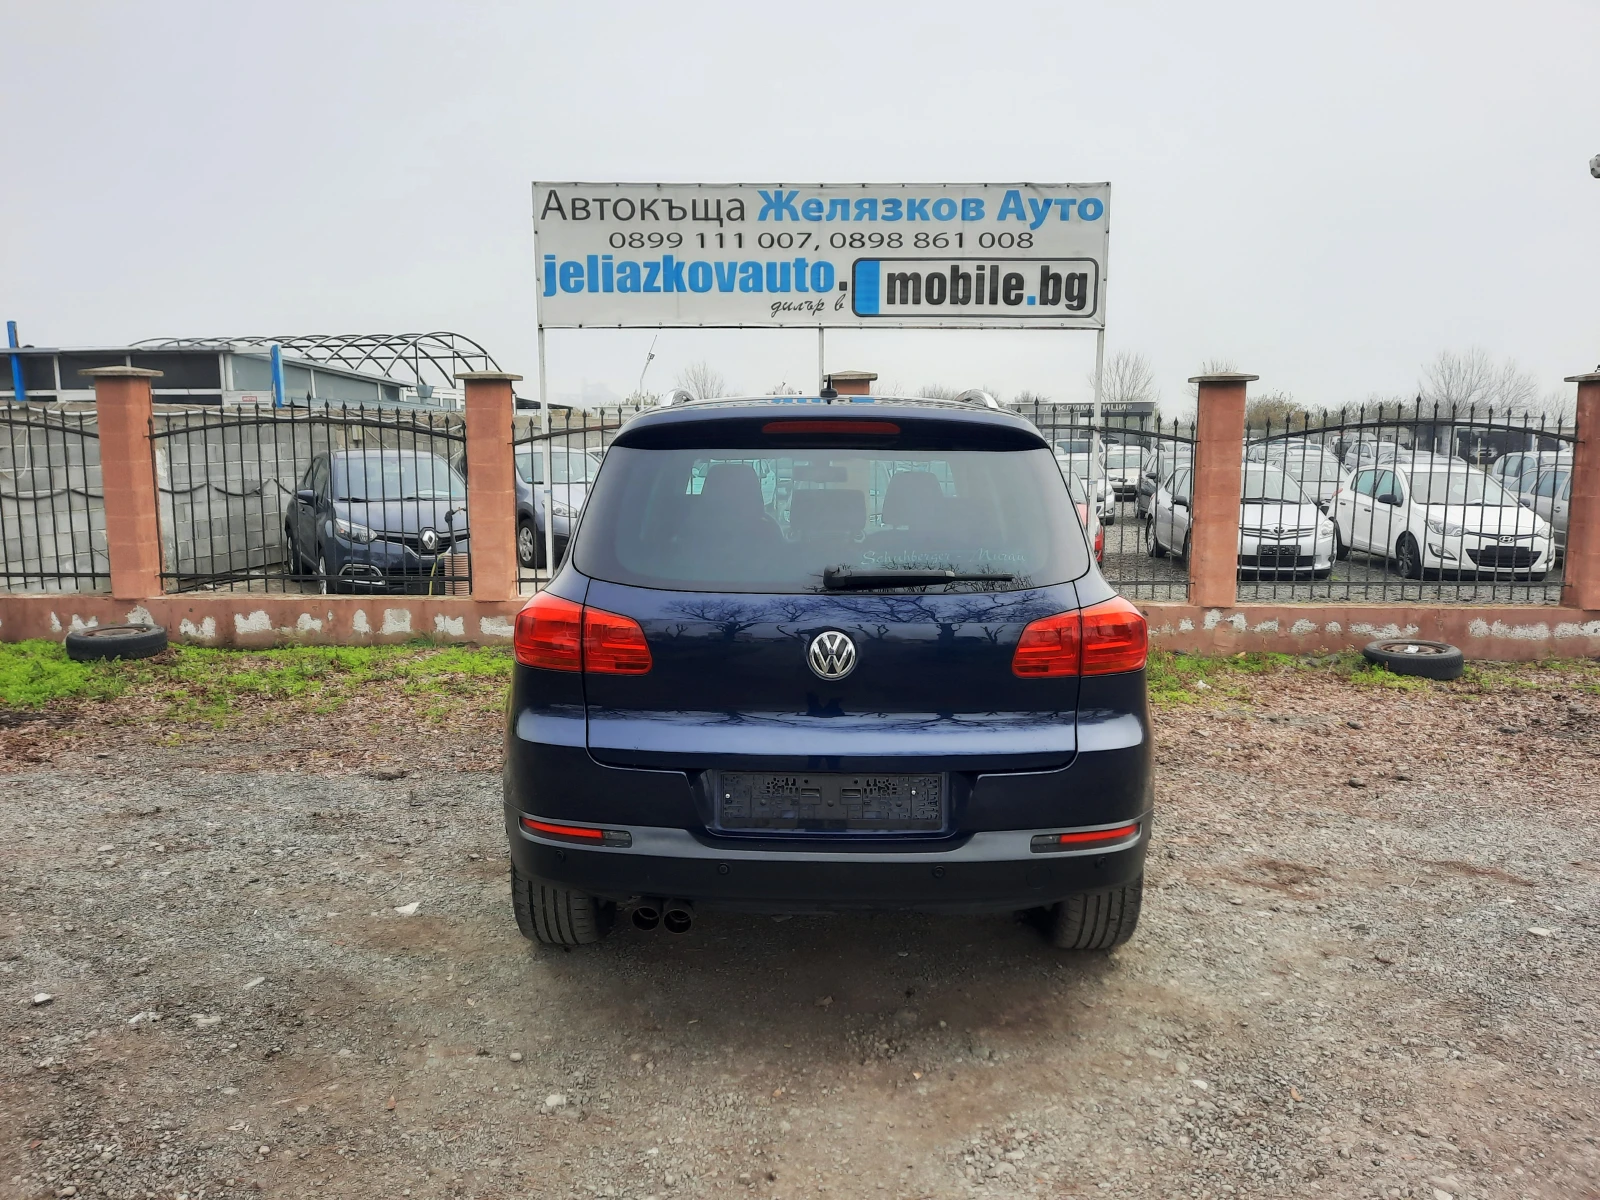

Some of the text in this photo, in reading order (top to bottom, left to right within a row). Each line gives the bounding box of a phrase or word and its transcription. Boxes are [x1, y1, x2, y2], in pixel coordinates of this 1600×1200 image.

[540, 189, 1104, 231] Автокъща Желязков Ауто
[608, 231, 1034, 251] 0899 111 007, 0898 861 008
[886, 264, 1089, 311] mobile.bg
